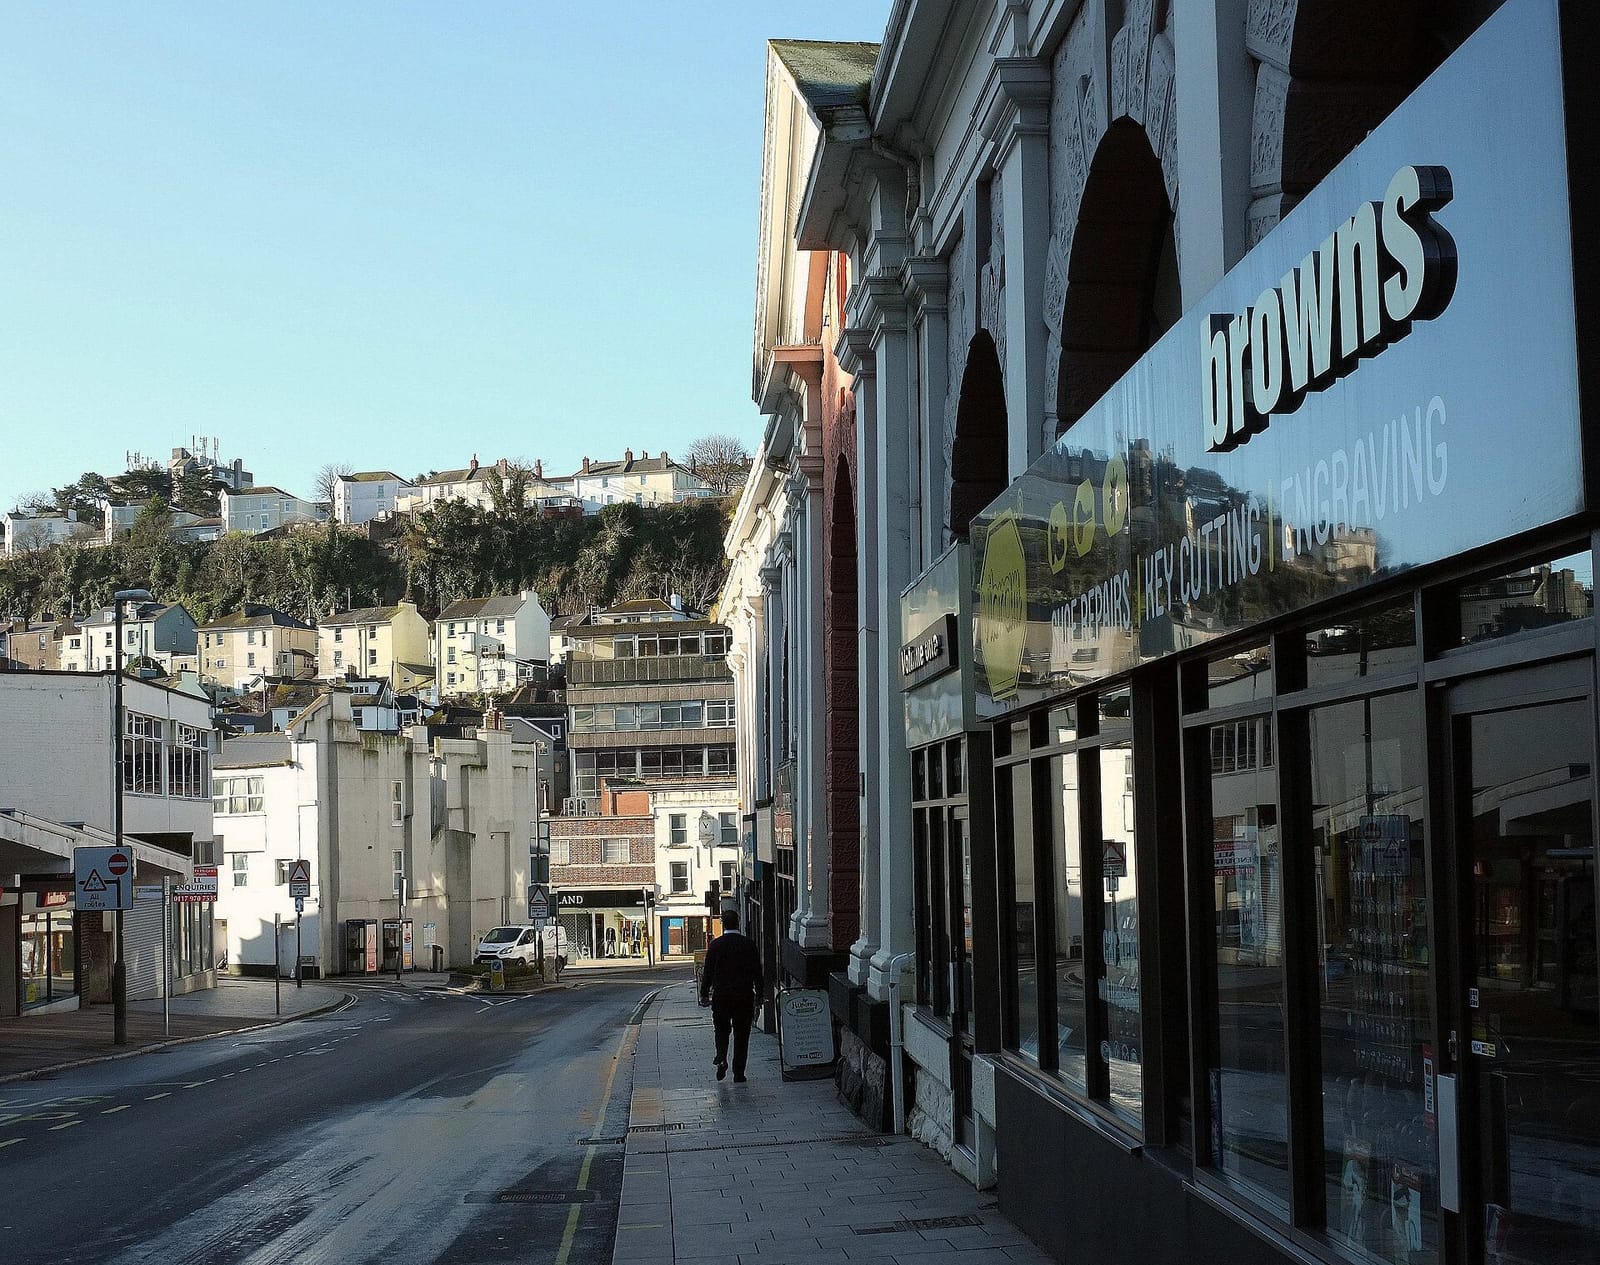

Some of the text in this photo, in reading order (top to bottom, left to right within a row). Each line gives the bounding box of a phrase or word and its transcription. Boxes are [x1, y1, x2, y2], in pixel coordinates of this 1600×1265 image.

[1201, 165, 1445, 452] browns
[1080, 569, 1131, 647] REPAIRS
[1145, 543, 1174, 622] KEY
[1180, 497, 1261, 605] CUTTING
[1281, 396, 1447, 561] ENGRAVING
